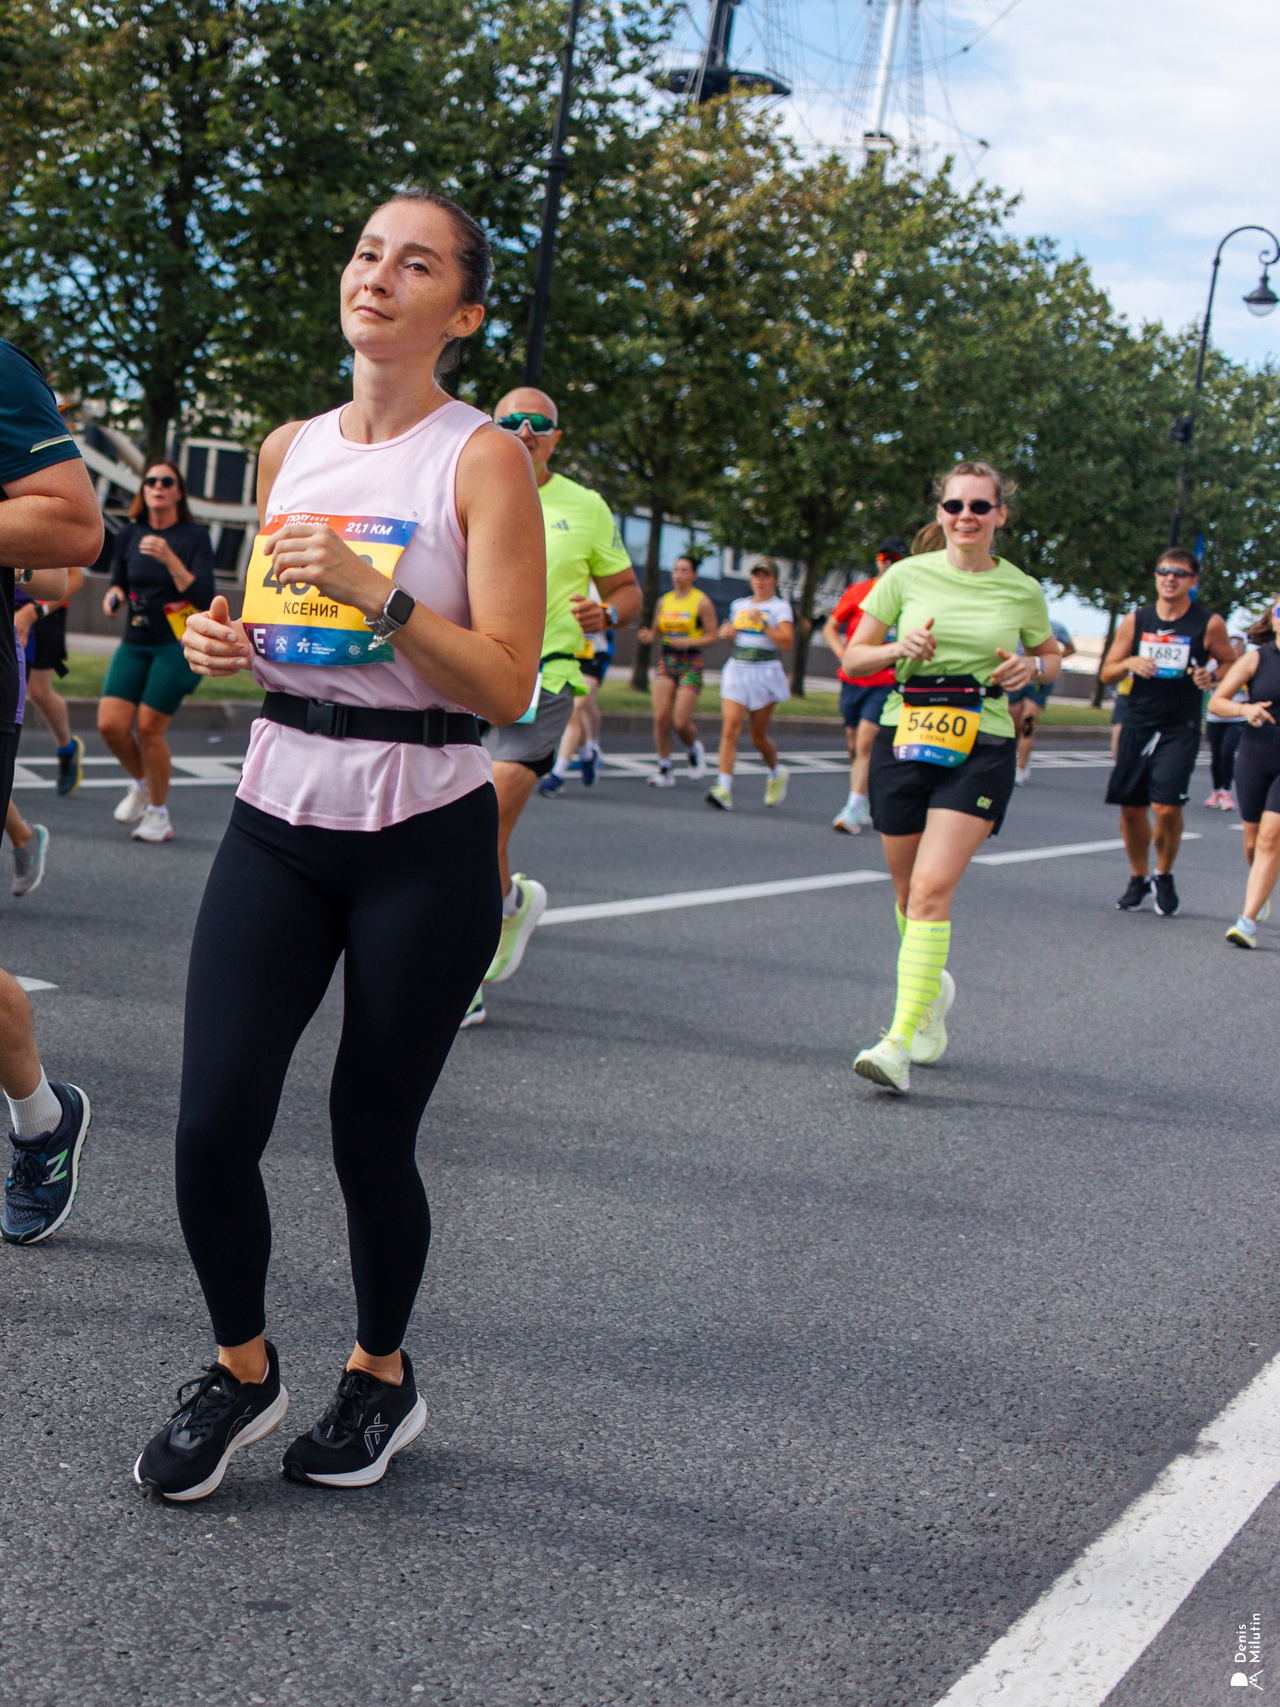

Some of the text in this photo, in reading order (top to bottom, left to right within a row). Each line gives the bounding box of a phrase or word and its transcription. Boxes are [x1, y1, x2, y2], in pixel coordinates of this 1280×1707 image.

[345, 522, 368, 535] 21,1
[282, 601, 339, 618] КСЕНИЯ
[1147, 647, 1183, 661] 1682
[907, 711, 968, 737] 5460
